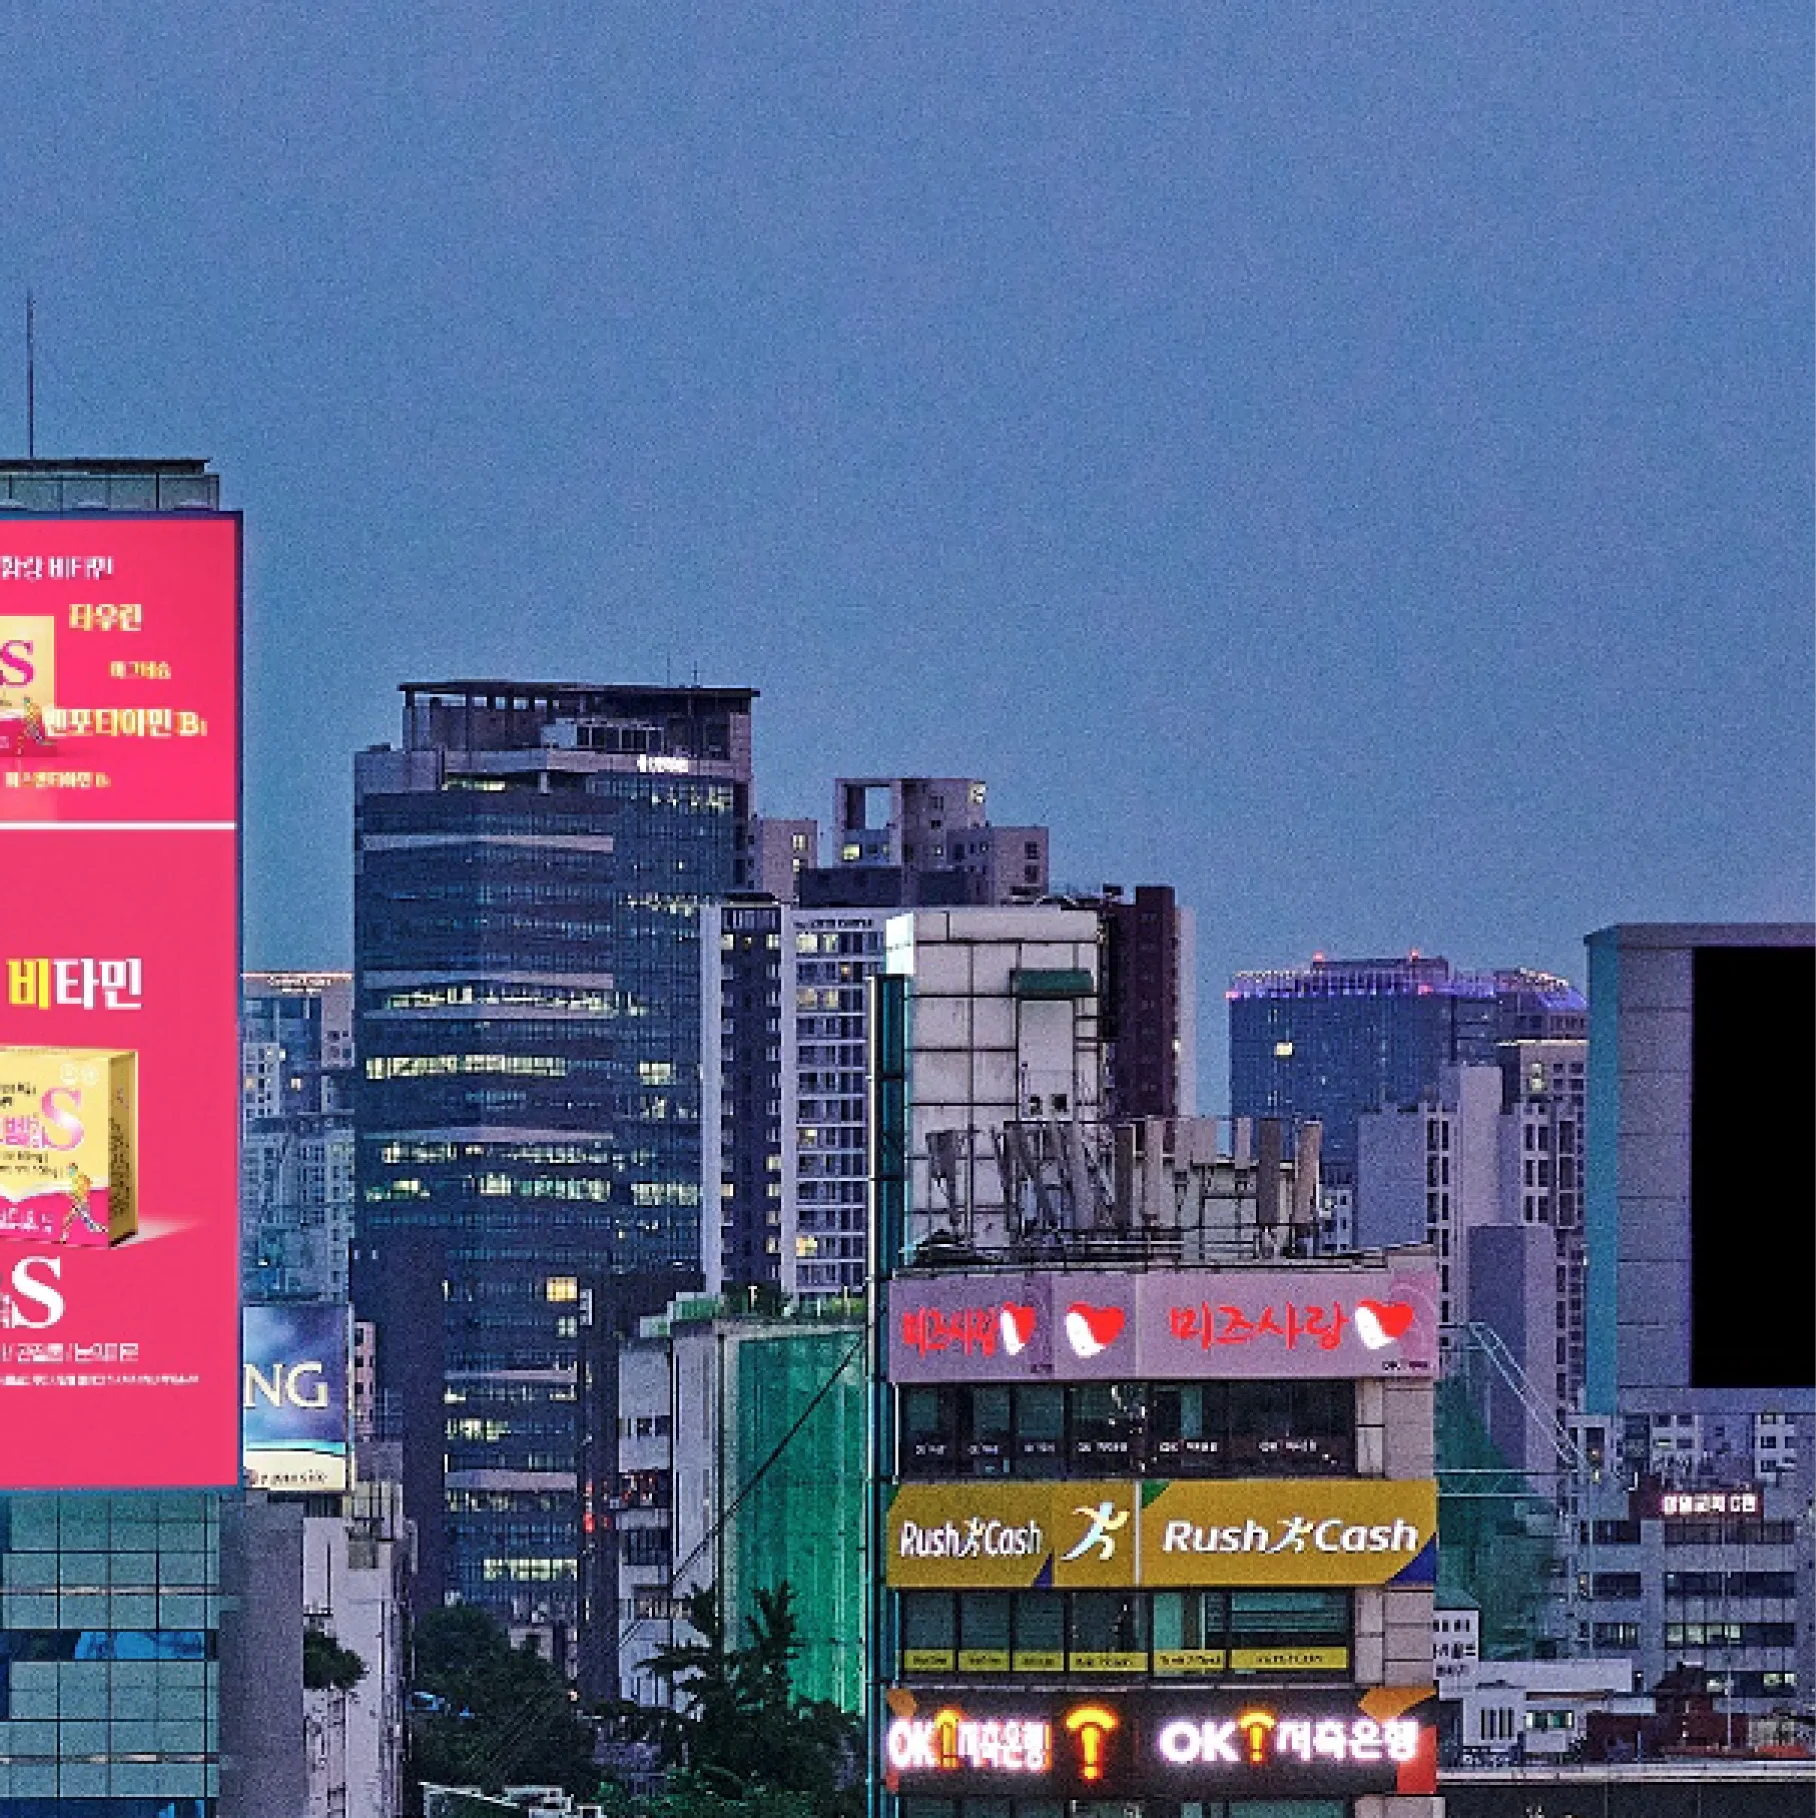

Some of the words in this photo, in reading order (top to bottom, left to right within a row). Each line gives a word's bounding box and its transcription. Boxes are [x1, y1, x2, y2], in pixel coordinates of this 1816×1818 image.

[7, 958, 144, 1011] 비타민
[1168, 1305, 1348, 1351] 미즈사랑
[1163, 1520, 1268, 1553] Rush
[1314, 1519, 1418, 1553] Cash
[1158, 1720, 1242, 1764] OK
[1275, 1717, 1420, 1765] 저축은행
